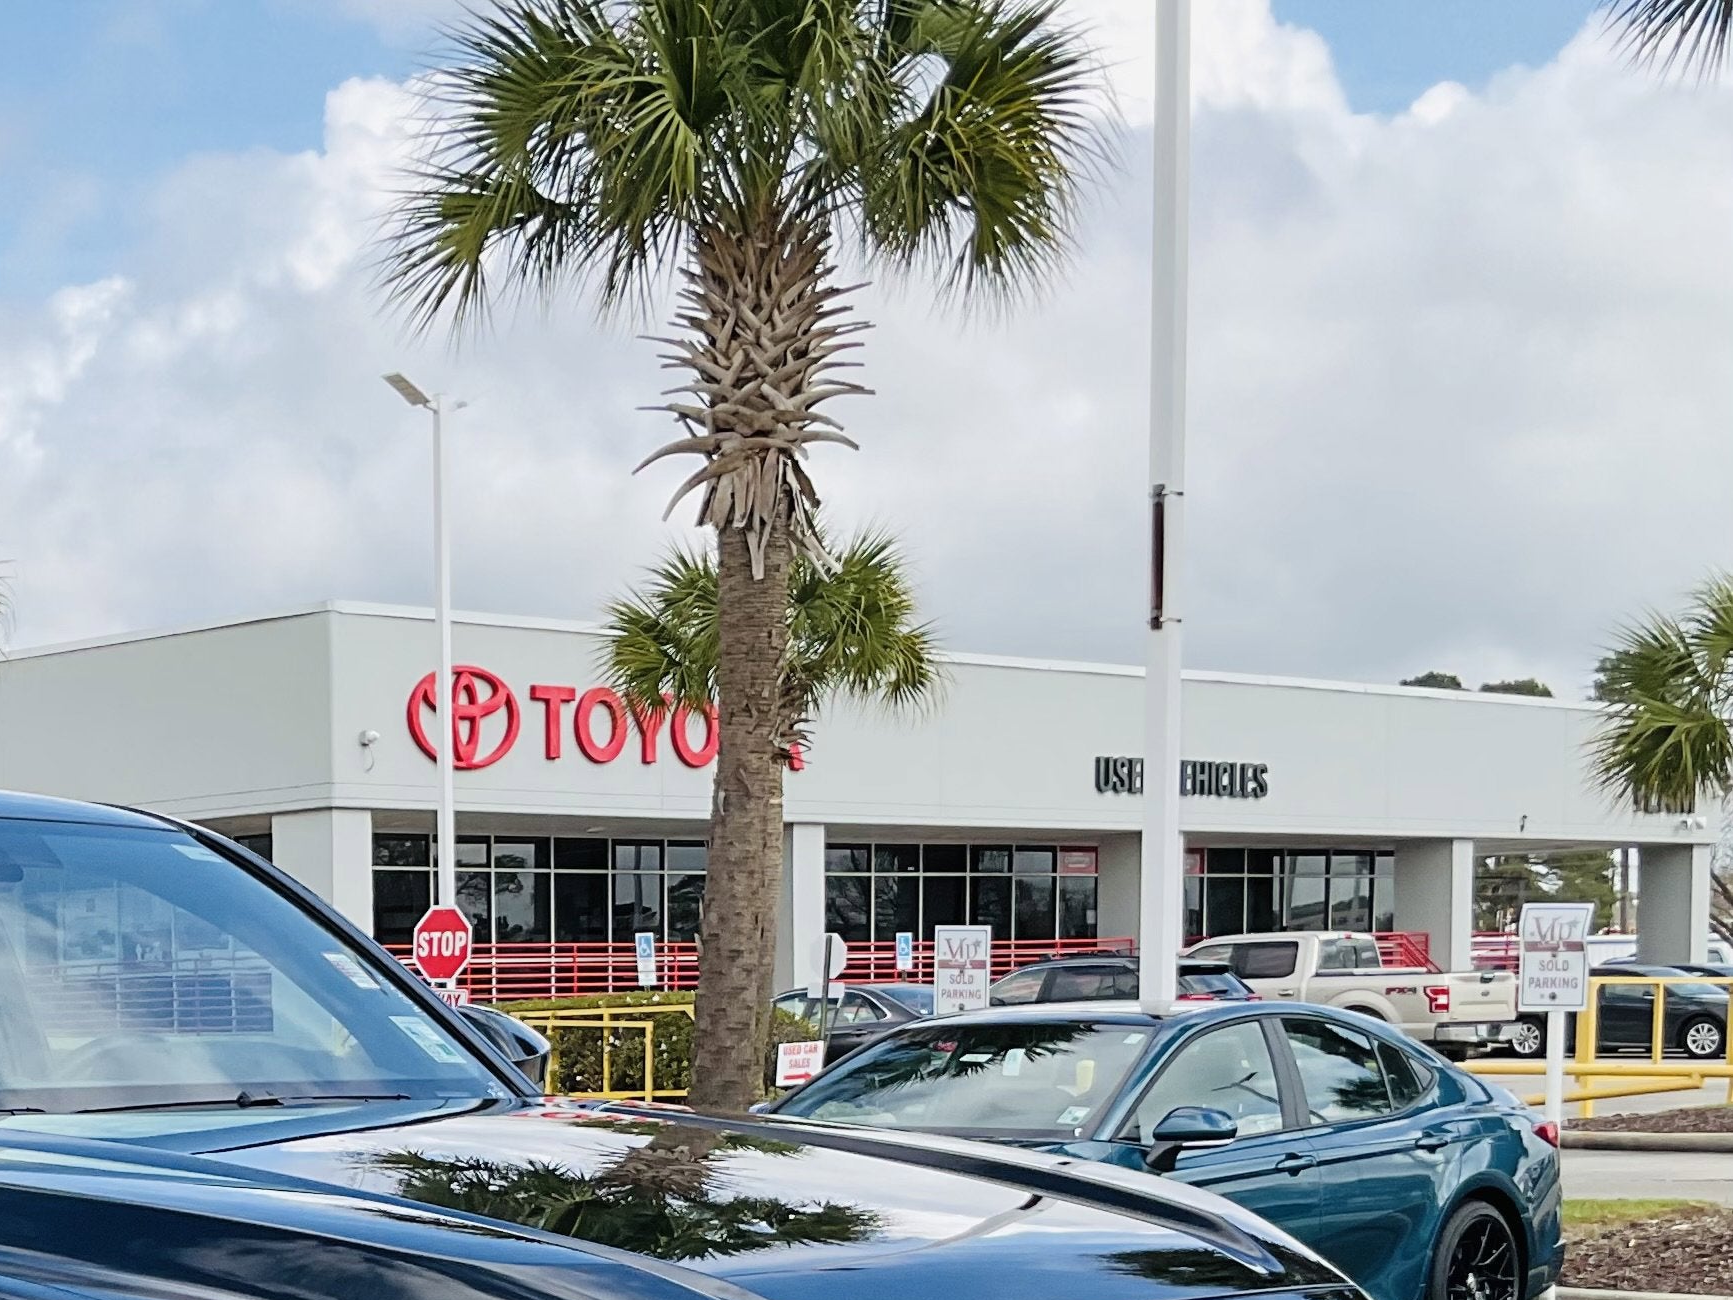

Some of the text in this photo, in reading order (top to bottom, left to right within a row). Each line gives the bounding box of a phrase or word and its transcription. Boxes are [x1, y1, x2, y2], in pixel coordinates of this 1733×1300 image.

[529, 684, 805, 772] TOYO
[1095, 756, 1269, 799] USE EHICLES
[418, 930, 467, 958] STOP
[1538, 959, 1570, 972] SOLD
[949, 974, 974, 985] SOLD
[1528, 977, 1579, 989] PARKING
[941, 988, 982, 1000] PARKING
[783, 1043, 818, 1056] USED CAR
[788, 1057, 811, 1069] SALES
